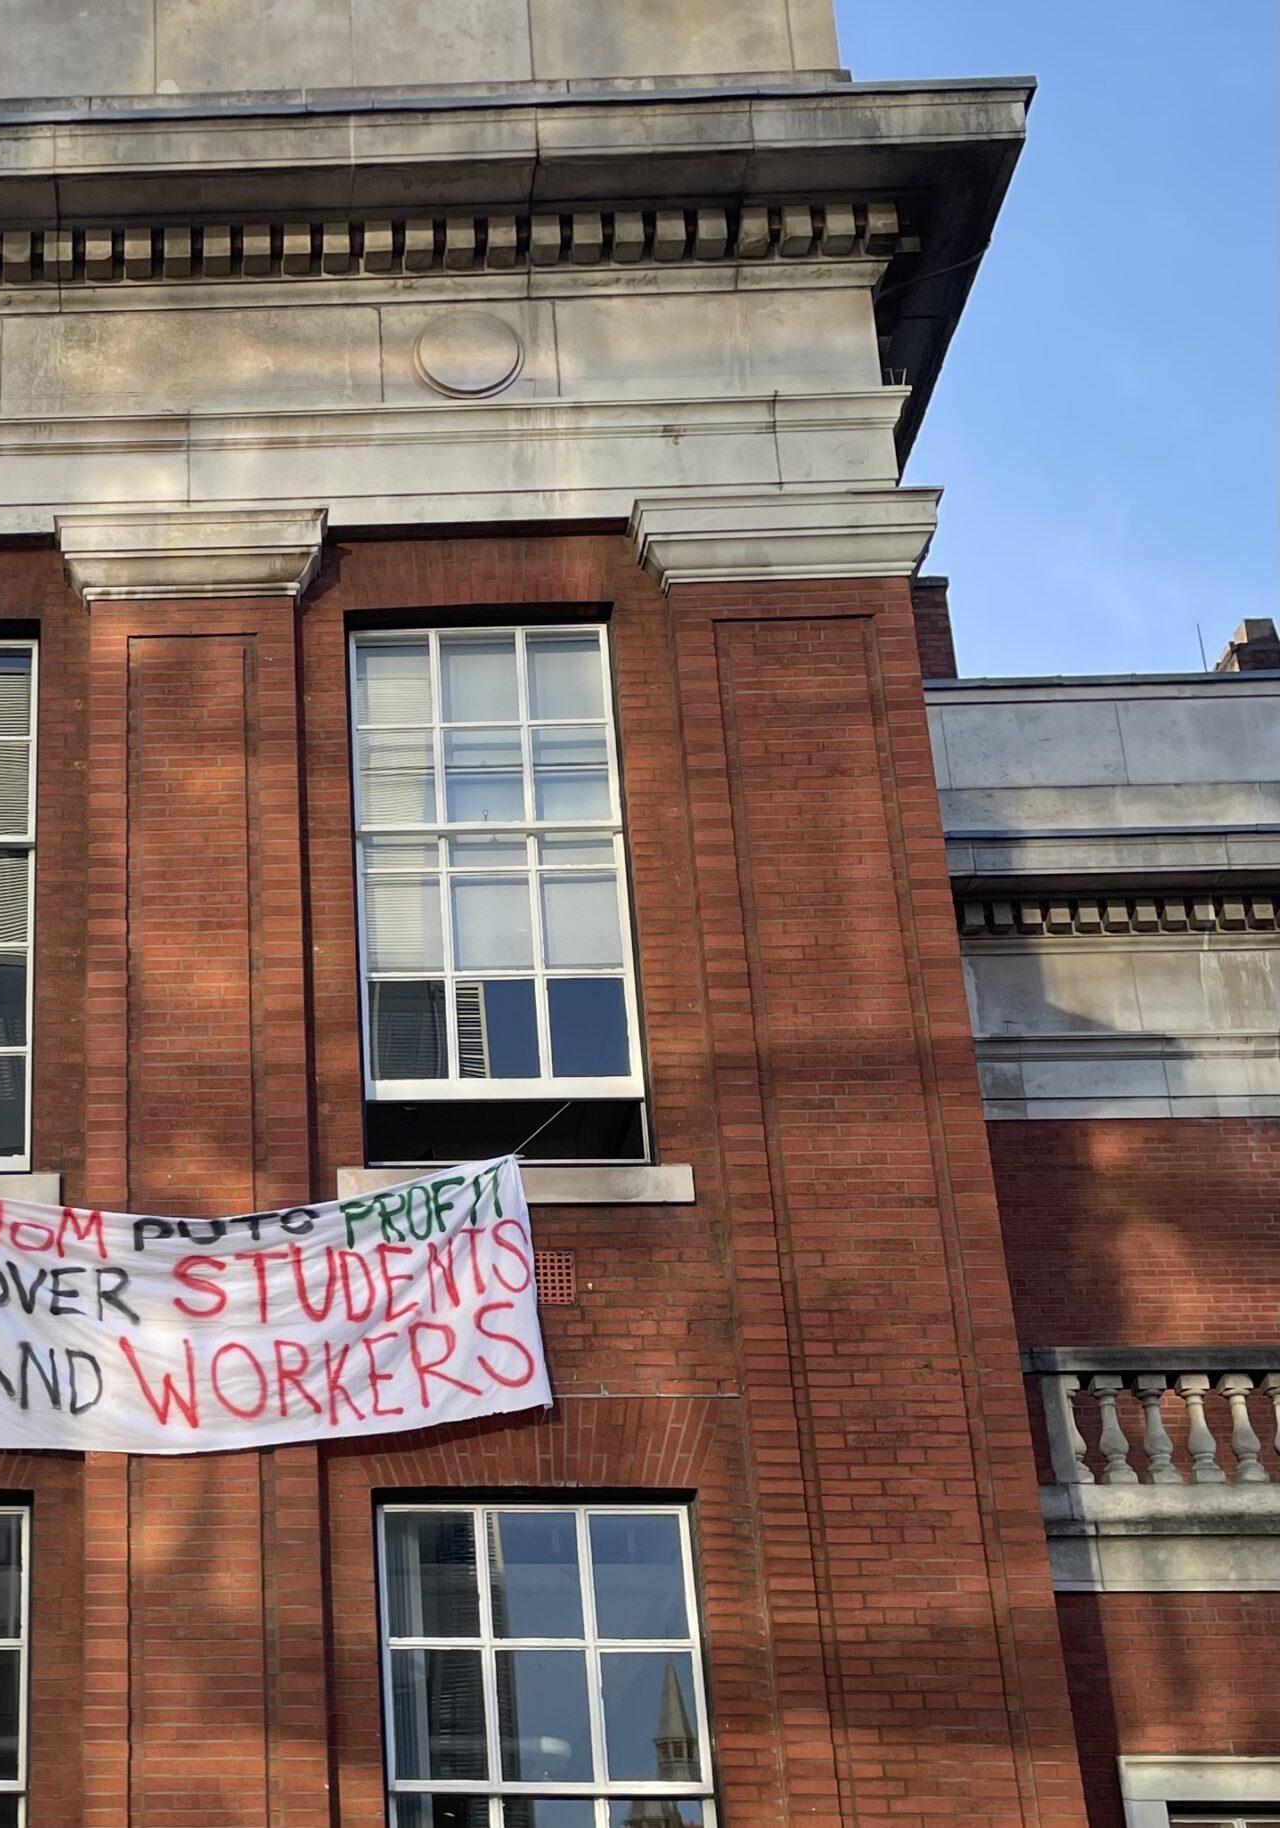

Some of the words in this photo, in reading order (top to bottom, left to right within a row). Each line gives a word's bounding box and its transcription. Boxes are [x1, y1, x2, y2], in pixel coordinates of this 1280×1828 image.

[339, 1159, 506, 1249] PROFIT
[172, 1218, 531, 1324] STUDENTS
[119, 1302, 536, 1430] WORKERS
